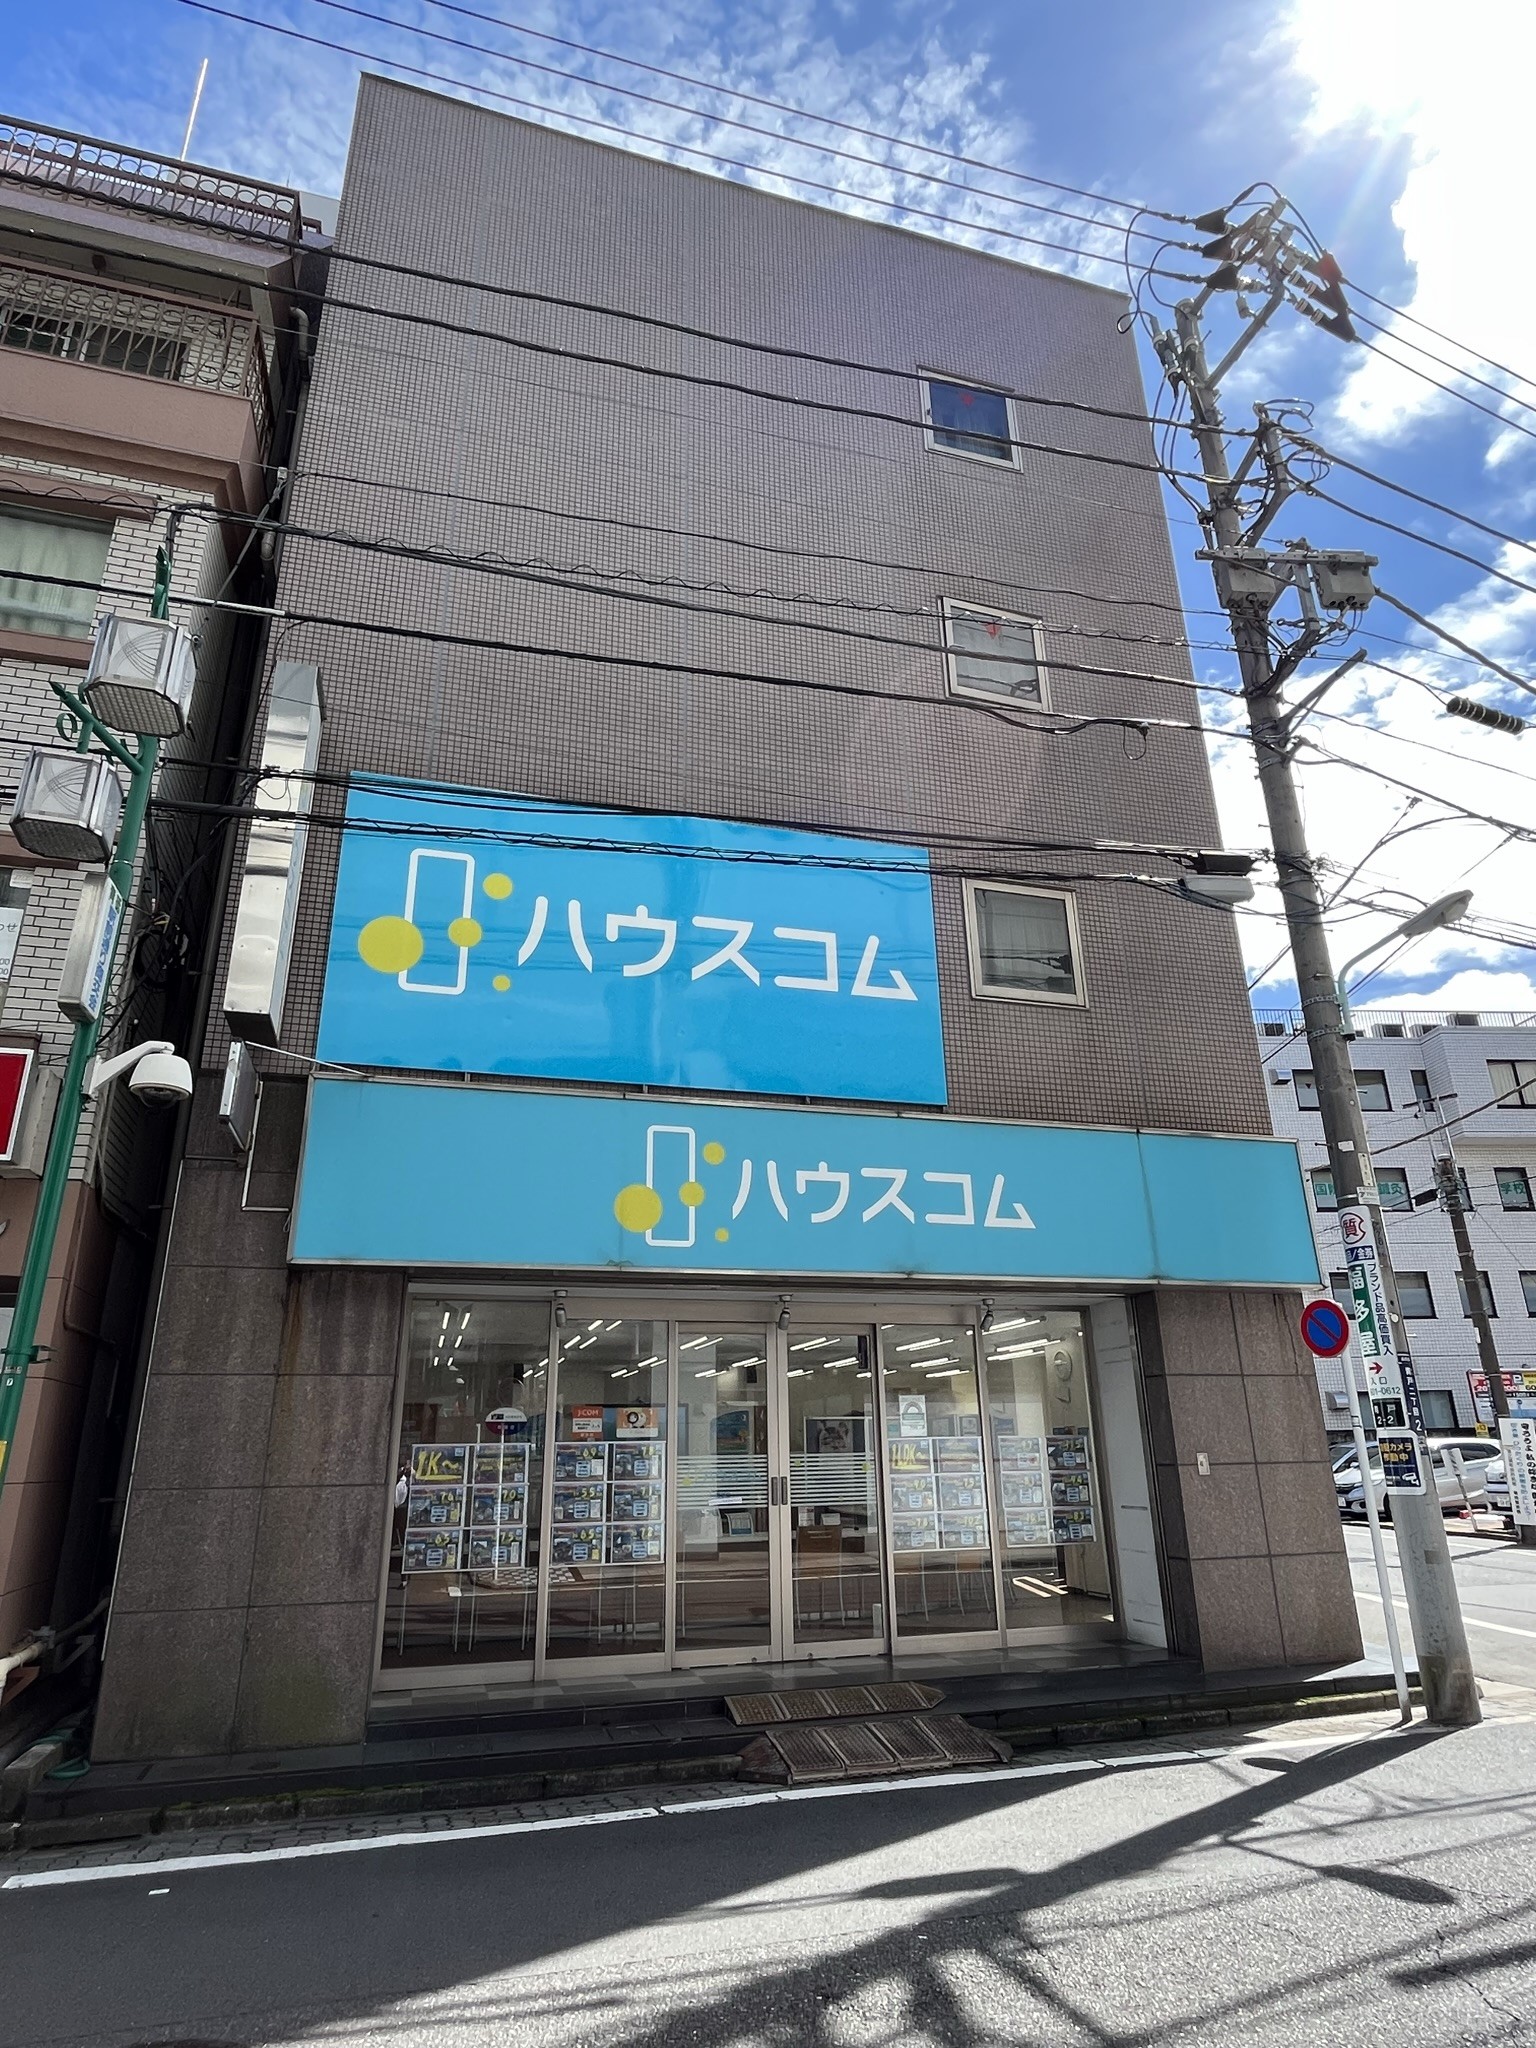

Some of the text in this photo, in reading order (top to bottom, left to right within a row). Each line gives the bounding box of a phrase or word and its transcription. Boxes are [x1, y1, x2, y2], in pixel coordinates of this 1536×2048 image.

[518, 896, 918, 1001] ハウスコム
[731, 1158, 1037, 1229] ハウスコム
[1343, 1218, 1360, 1239] 質
[1415, 1419, 1422, 1431] 2
